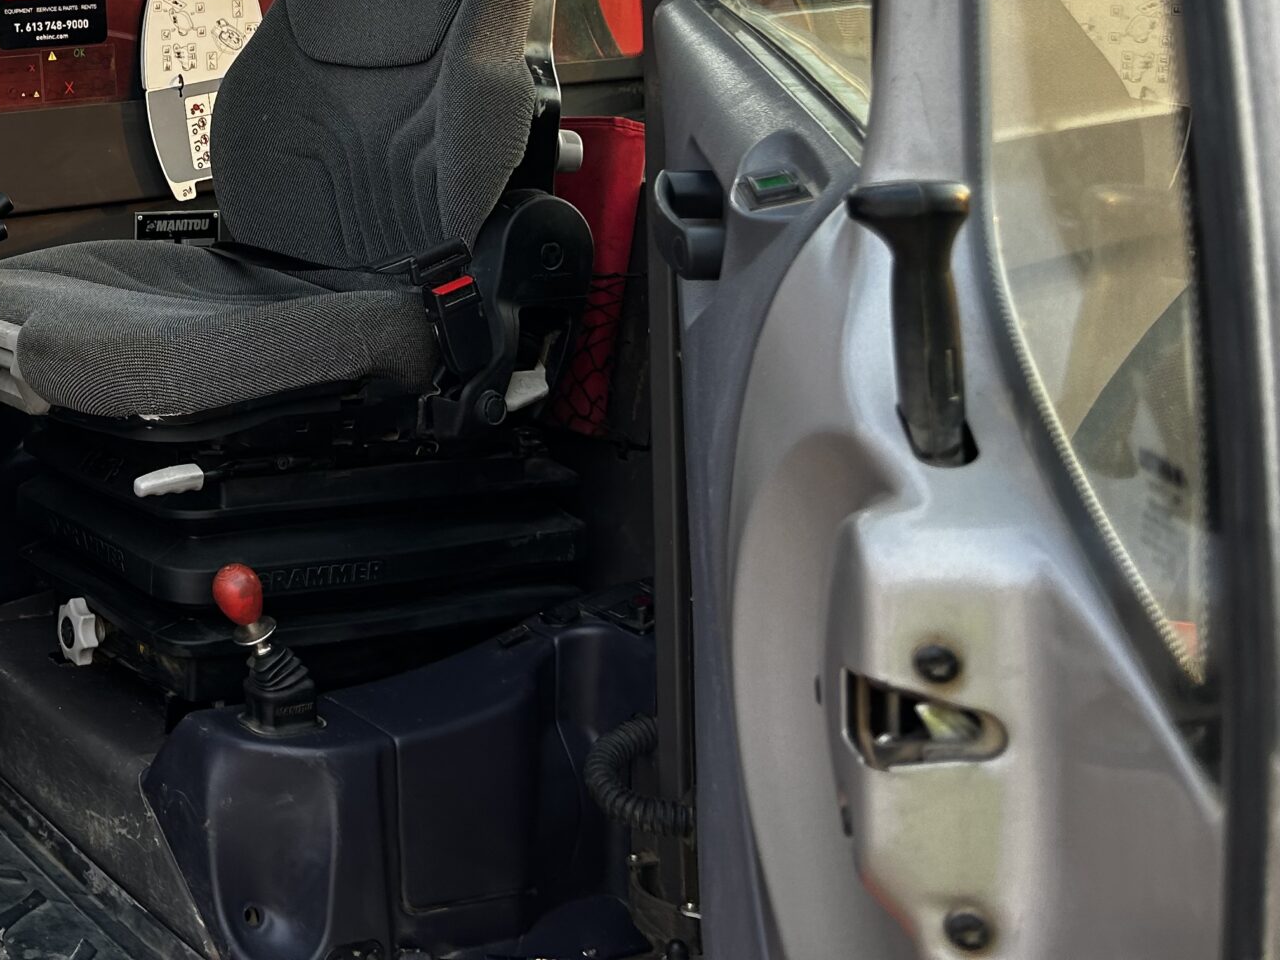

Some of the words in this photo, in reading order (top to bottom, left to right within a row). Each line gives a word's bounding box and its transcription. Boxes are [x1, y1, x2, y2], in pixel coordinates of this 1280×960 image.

[4, 7, 33, 15] EQUIPMENT
[36, 5, 57, 13] SERVICE
[14, 22, 24, 33] T.
[25, 21, 43, 32] 613
[45, 19, 89, 31] 748-9000
[73, 48, 86, 58] OK
[155, 218, 210, 232] MANITOU
